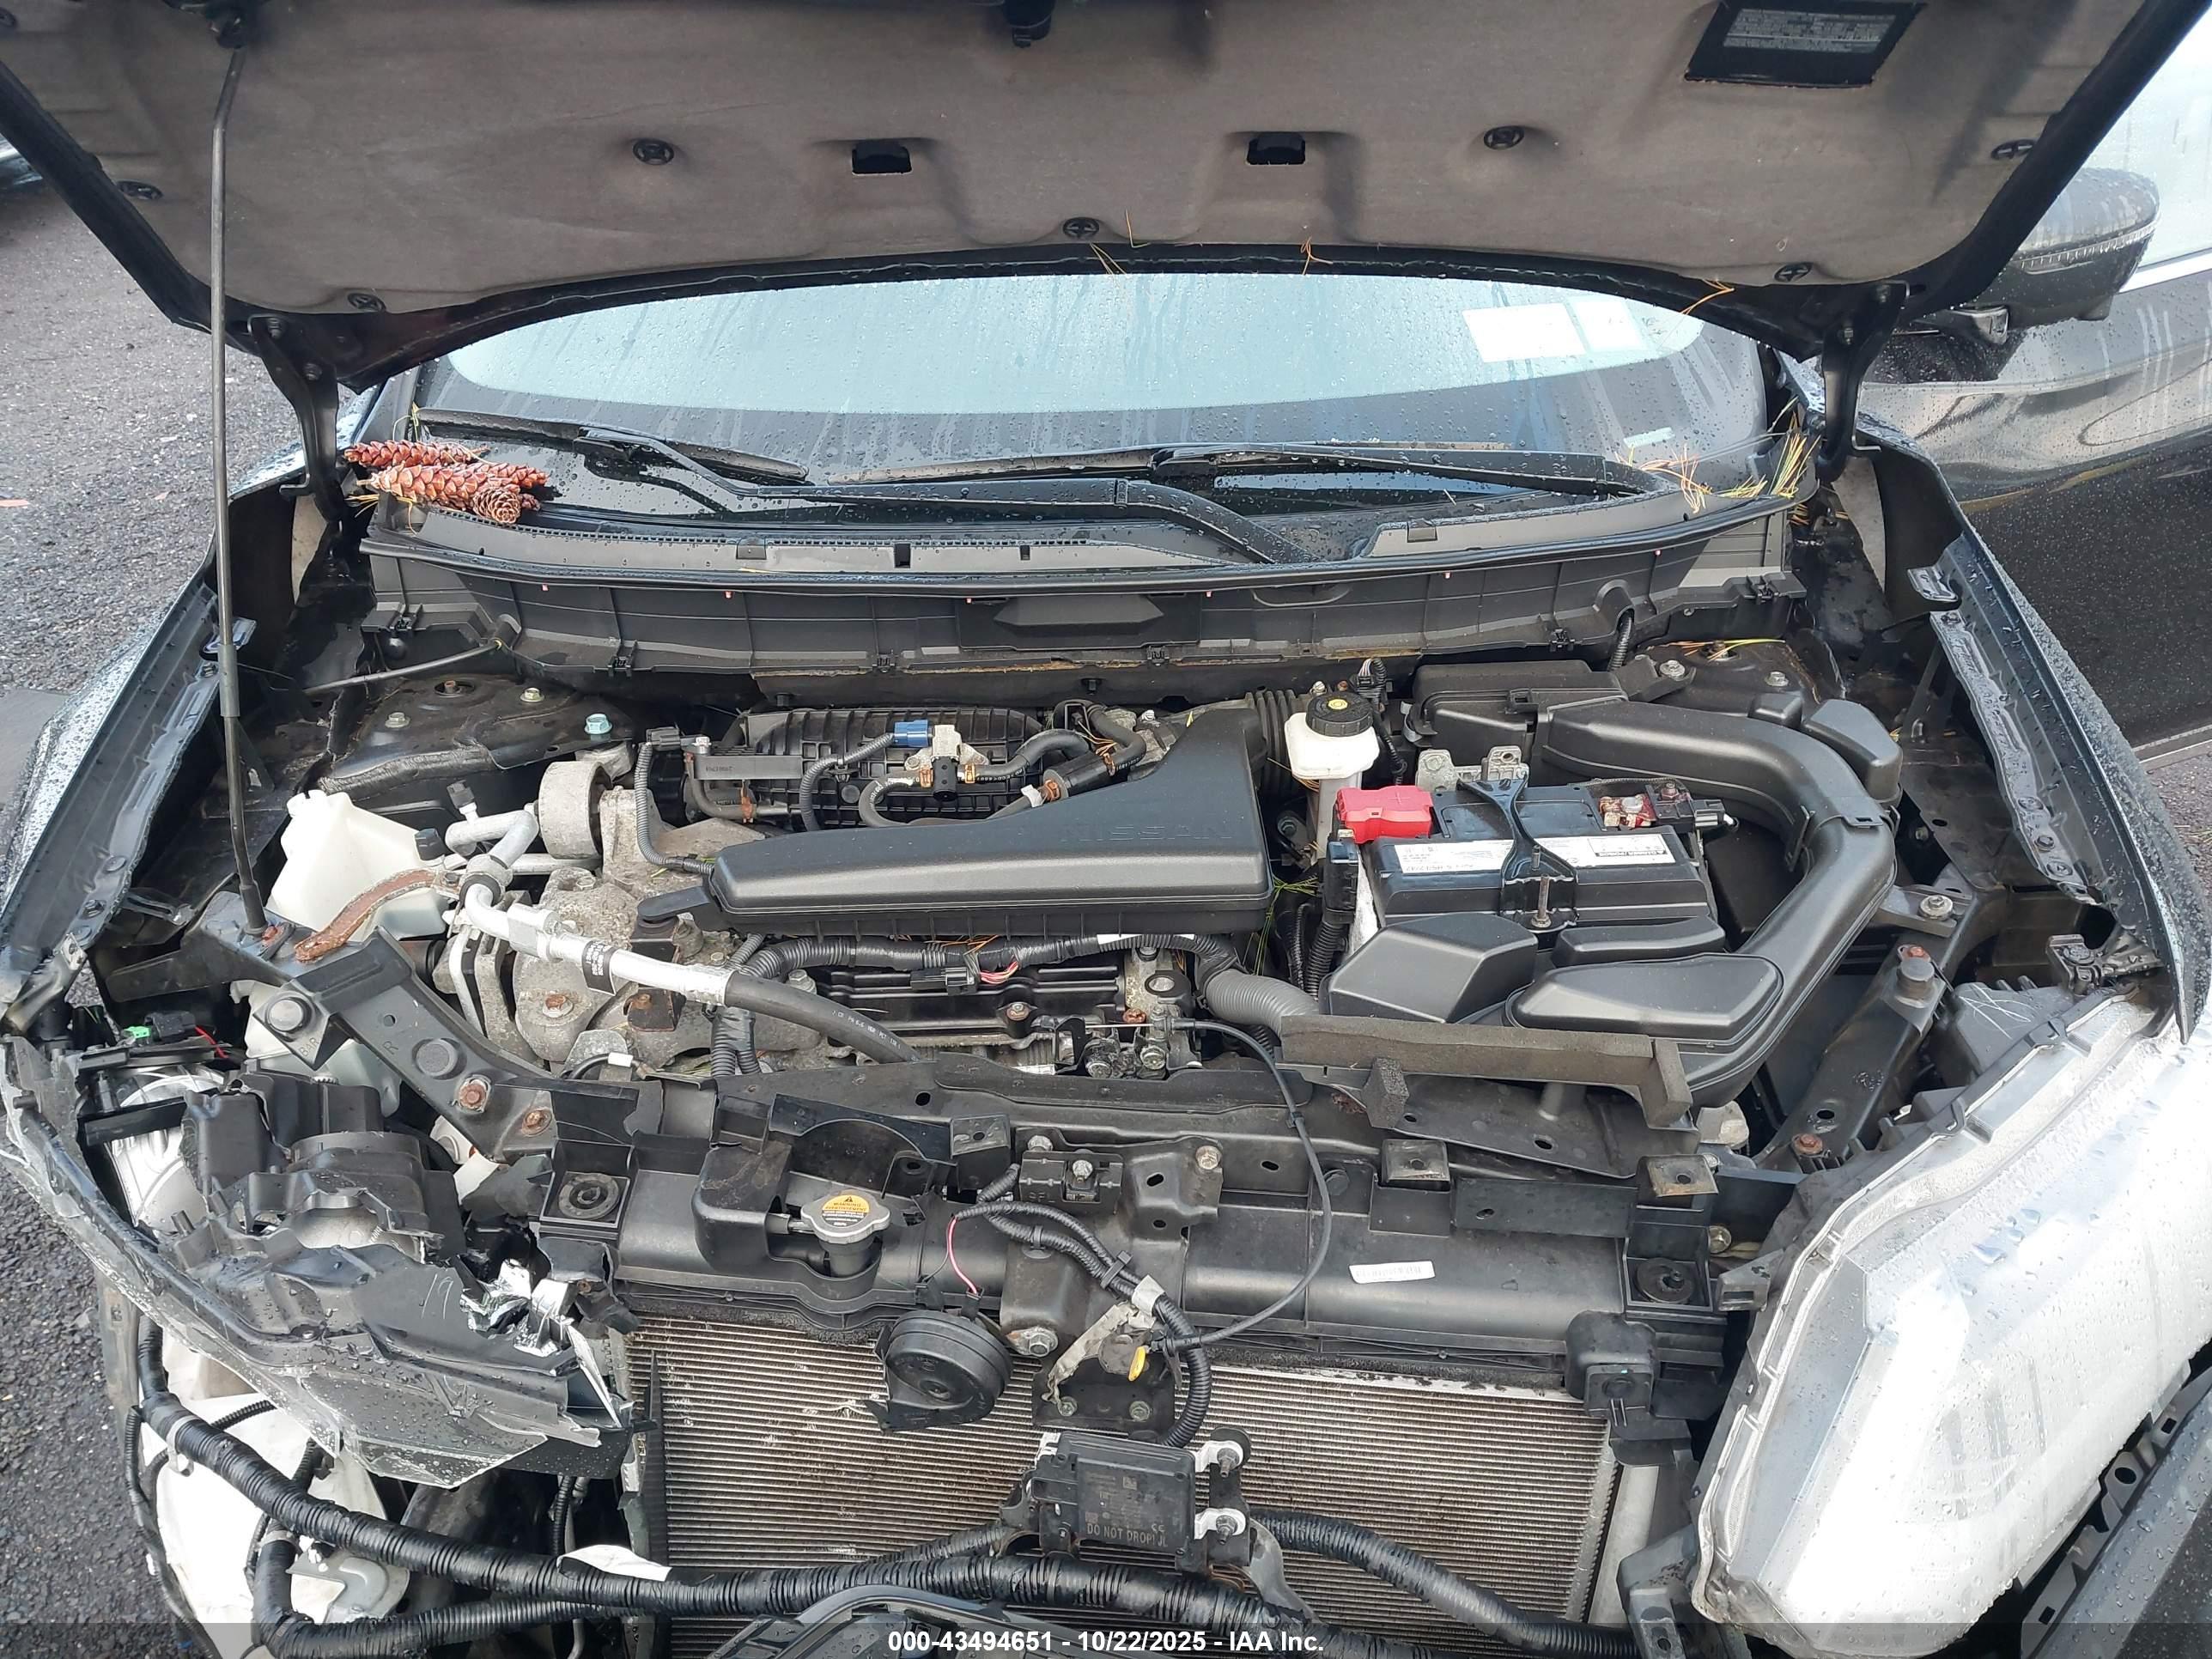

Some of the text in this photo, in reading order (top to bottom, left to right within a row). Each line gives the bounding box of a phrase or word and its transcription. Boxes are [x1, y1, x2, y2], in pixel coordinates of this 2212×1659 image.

[298, 1037, 319, 1057] BAR
[382, 1040, 398, 1055] R
[1087, 1522, 1100, 1535] DO
[1104, 1525, 1123, 1539] NOT
